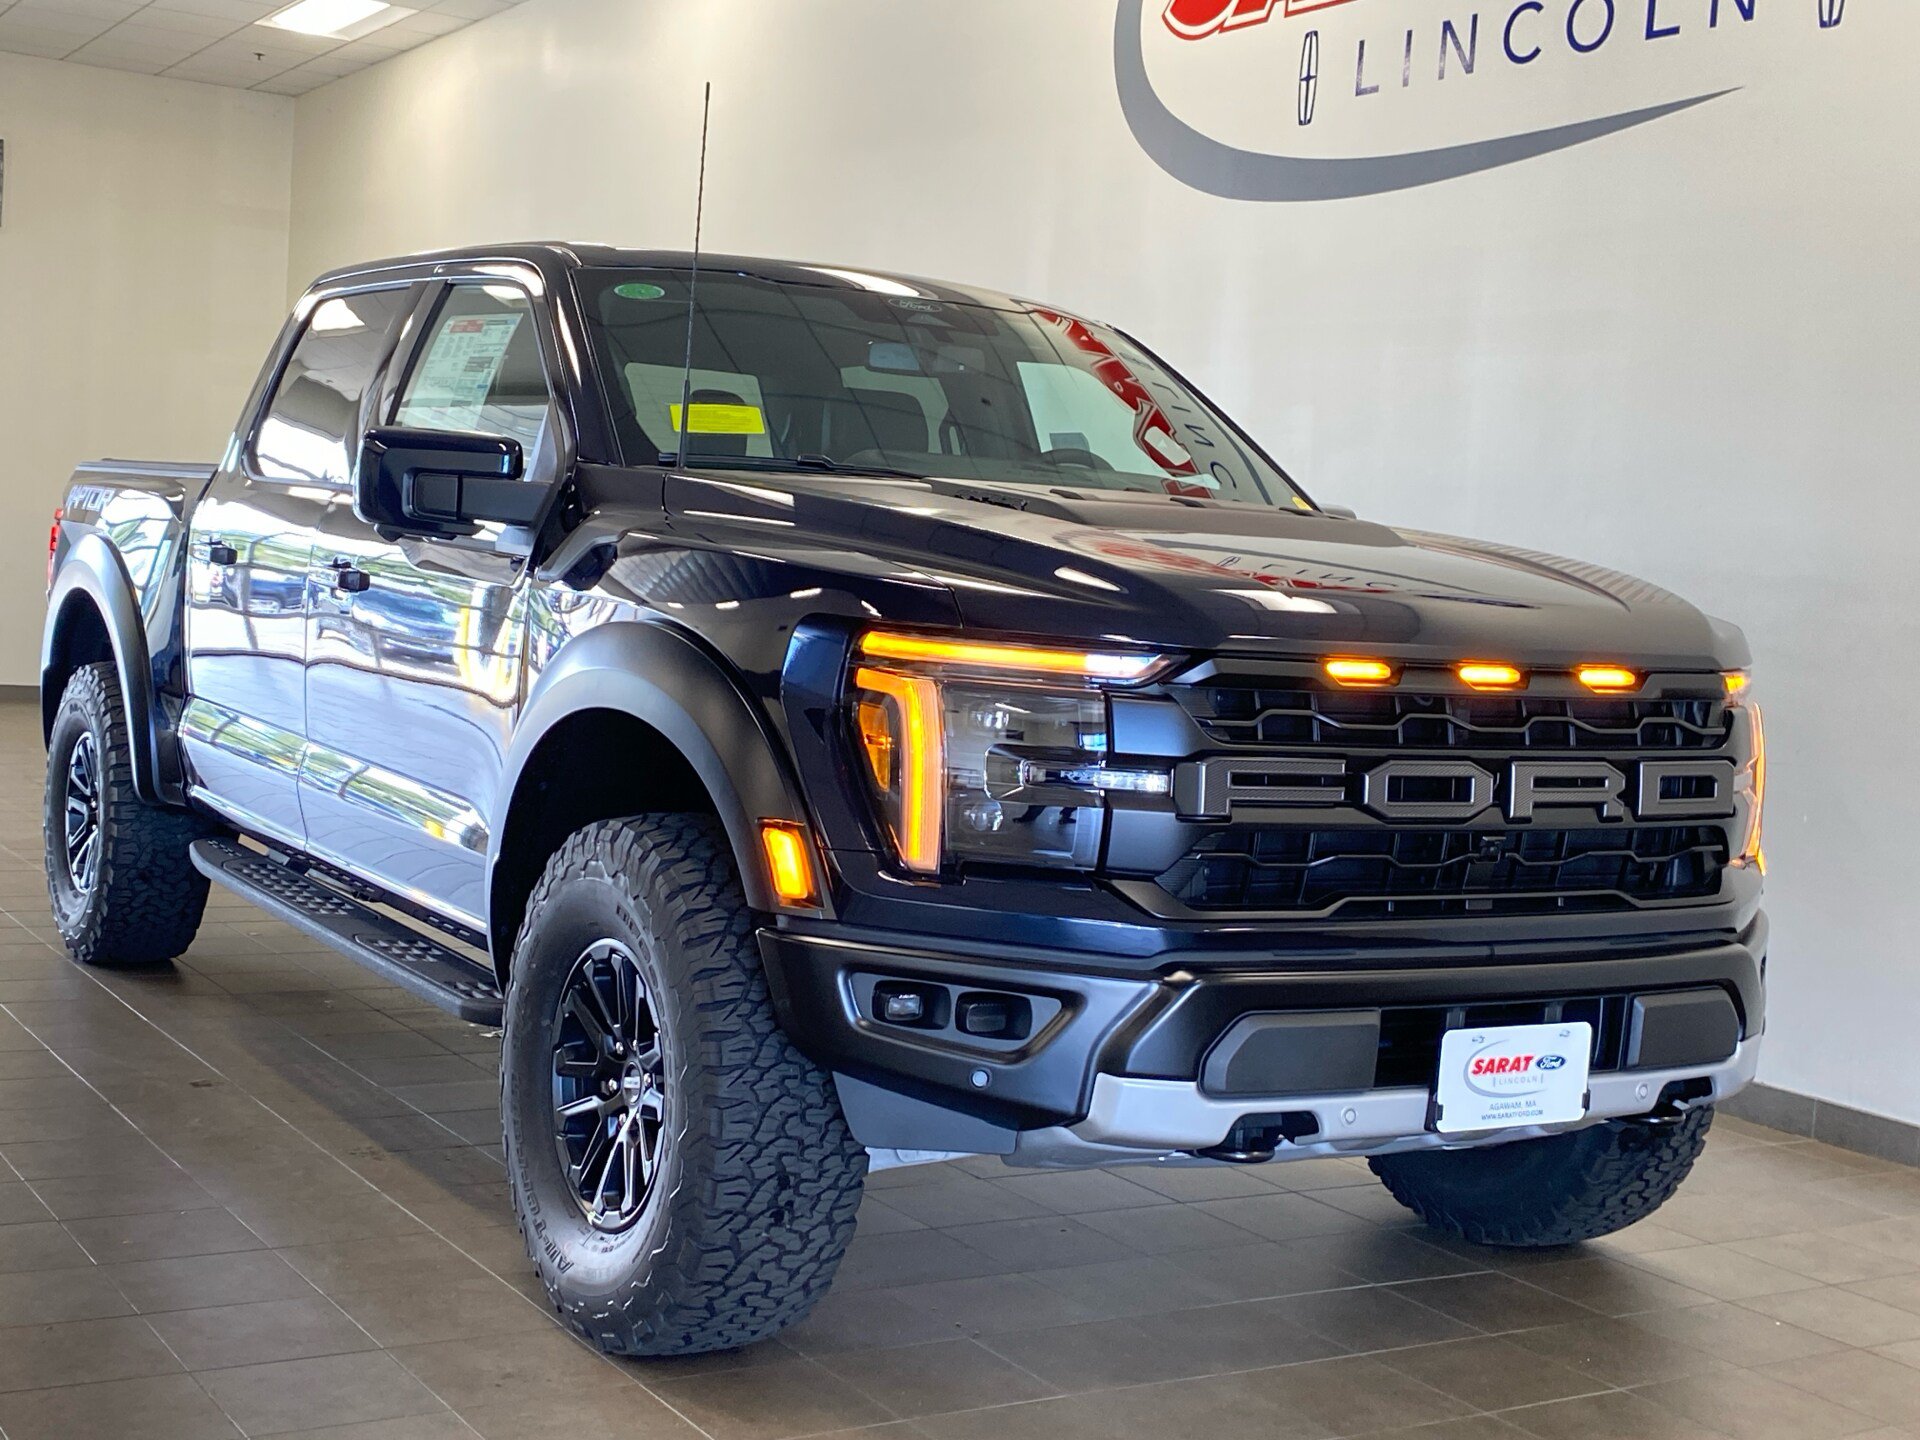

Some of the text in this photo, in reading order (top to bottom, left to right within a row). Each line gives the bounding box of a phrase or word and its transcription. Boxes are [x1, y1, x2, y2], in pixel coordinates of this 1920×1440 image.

[1173, 756, 1736, 823] FORD
[1471, 1055, 1565, 1075] SARAT Ford
[1498, 1076, 1538, 1085] LINCOLN
